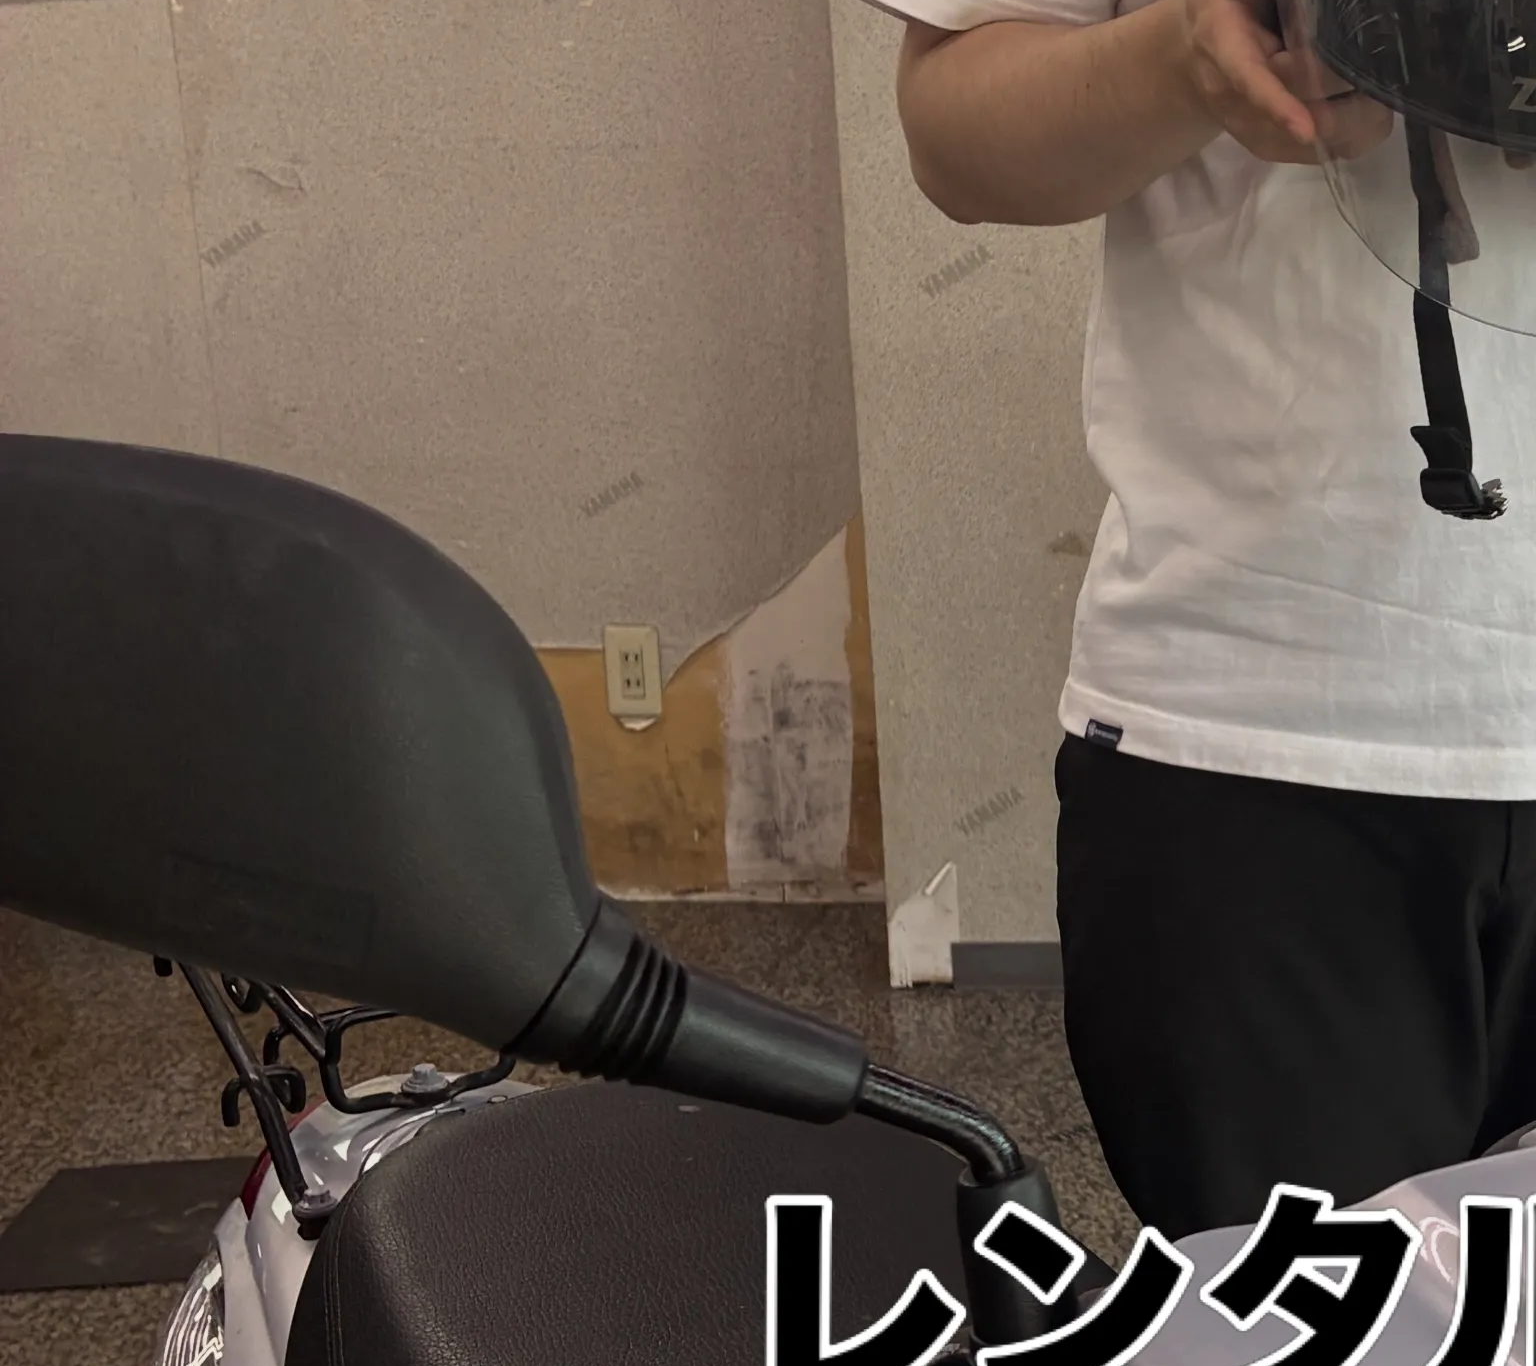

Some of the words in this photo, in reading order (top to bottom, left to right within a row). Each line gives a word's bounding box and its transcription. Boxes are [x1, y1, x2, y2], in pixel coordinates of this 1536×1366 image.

[200, 220, 265, 269] YAMAHA
[578, 471, 644, 517] YAMAHA
[953, 786, 1026, 836] YAMAHA
